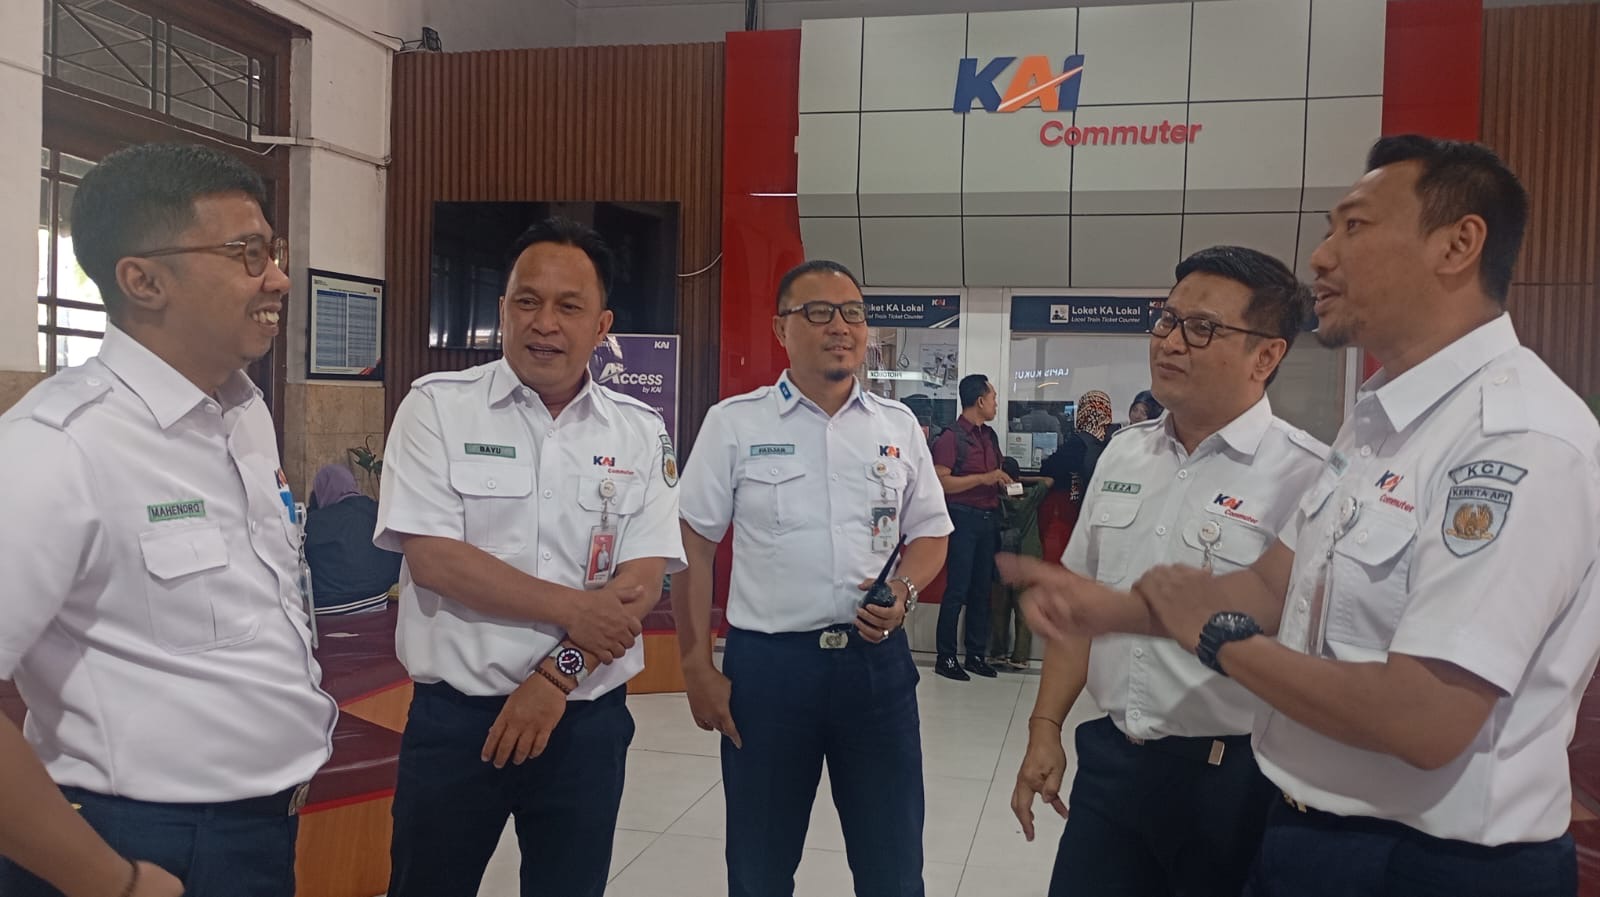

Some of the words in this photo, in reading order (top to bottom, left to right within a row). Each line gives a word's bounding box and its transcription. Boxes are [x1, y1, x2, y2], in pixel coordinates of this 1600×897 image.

[953, 54, 1085, 113] KAI
[1039, 120, 1202, 147] Commuter
[886, 304, 899, 312] KA
[901, 304, 924, 312] Lokal
[1071, 306, 1097, 315] Loket
[1100, 306, 1113, 315] KA
[1116, 306, 1141, 315] Lokal
[654, 341, 670, 349] KAI
[599, 362, 664, 386] Access
[479, 446, 501, 454] BAYU
[879, 445, 901, 458] KAI
[593, 456, 615, 467] KAI
[1467, 463, 1505, 477] KCI
[1374, 469, 1404, 493] KAI
[1213, 493, 1243, 510] KAI
[1452, 487, 1488, 499] KERETA
[1490, 490, 1508, 502] API
[1379, 494, 1415, 513] Commuter
[1224, 508, 1259, 524] Commuter
